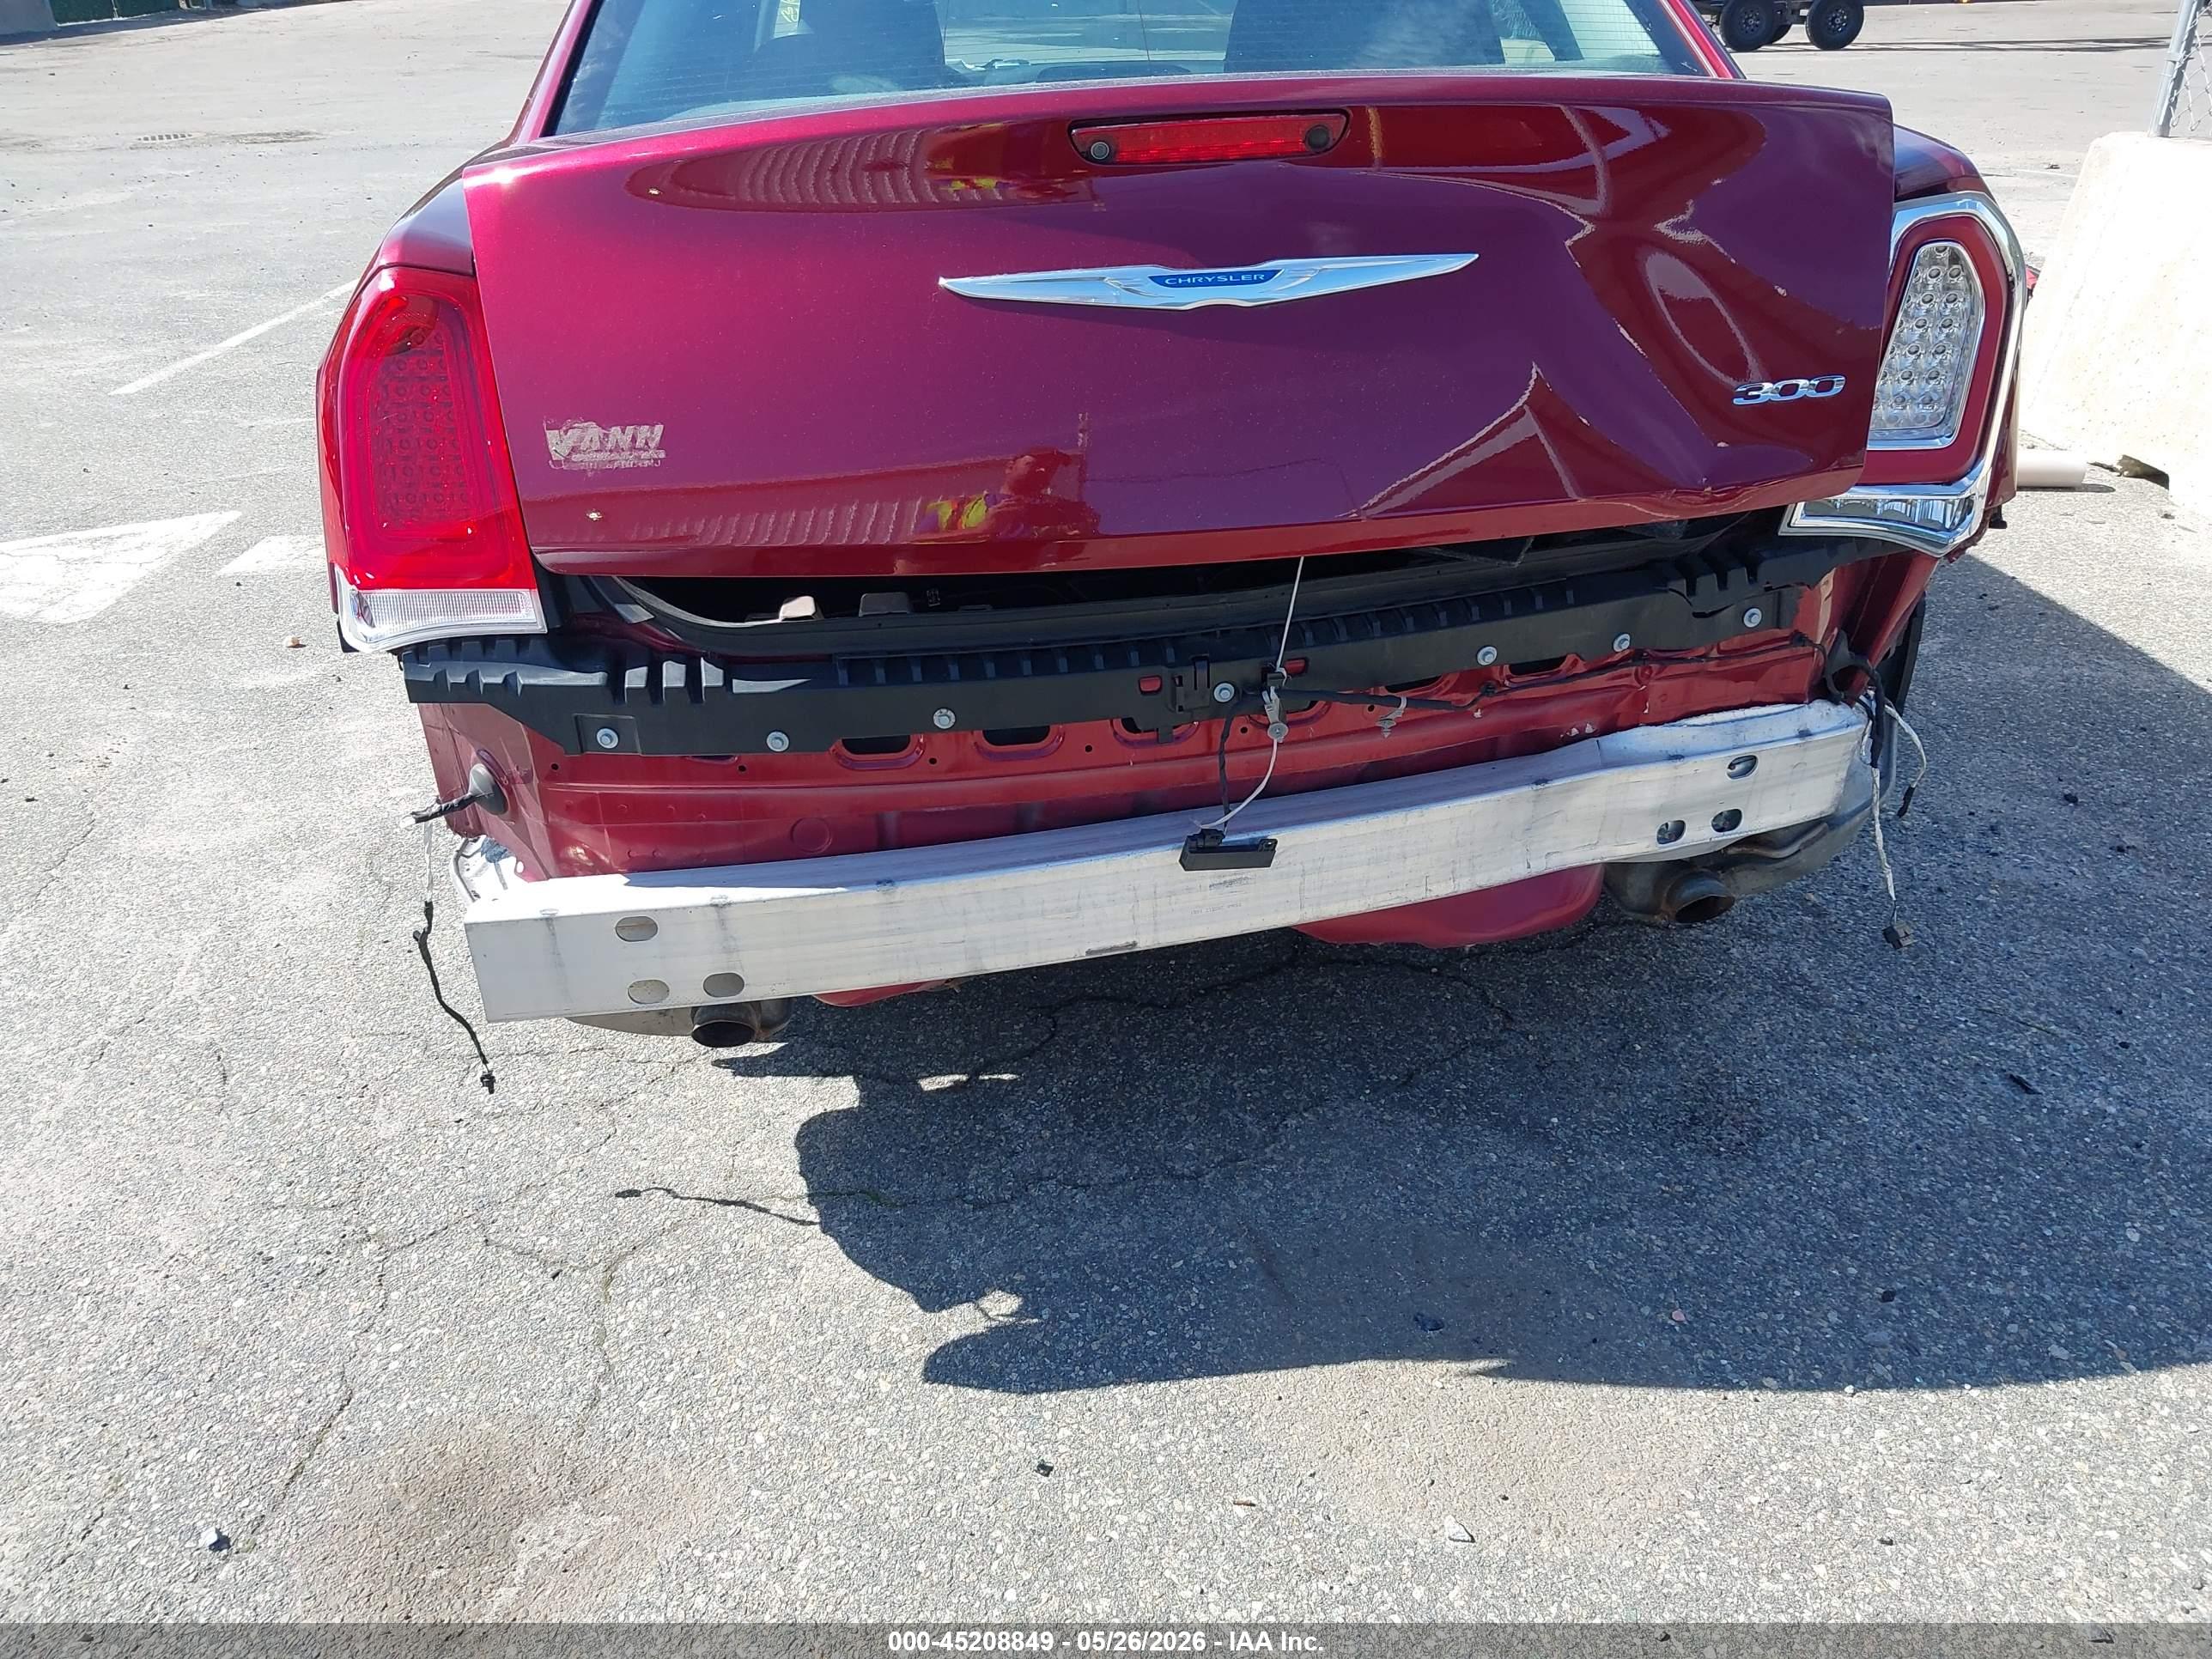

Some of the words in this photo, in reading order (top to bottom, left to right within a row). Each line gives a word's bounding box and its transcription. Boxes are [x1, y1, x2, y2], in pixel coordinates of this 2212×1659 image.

[1164, 273, 1266, 285] CHRYSLER
[1732, 374, 1845, 405] 300
[545, 422, 665, 461] VANN
